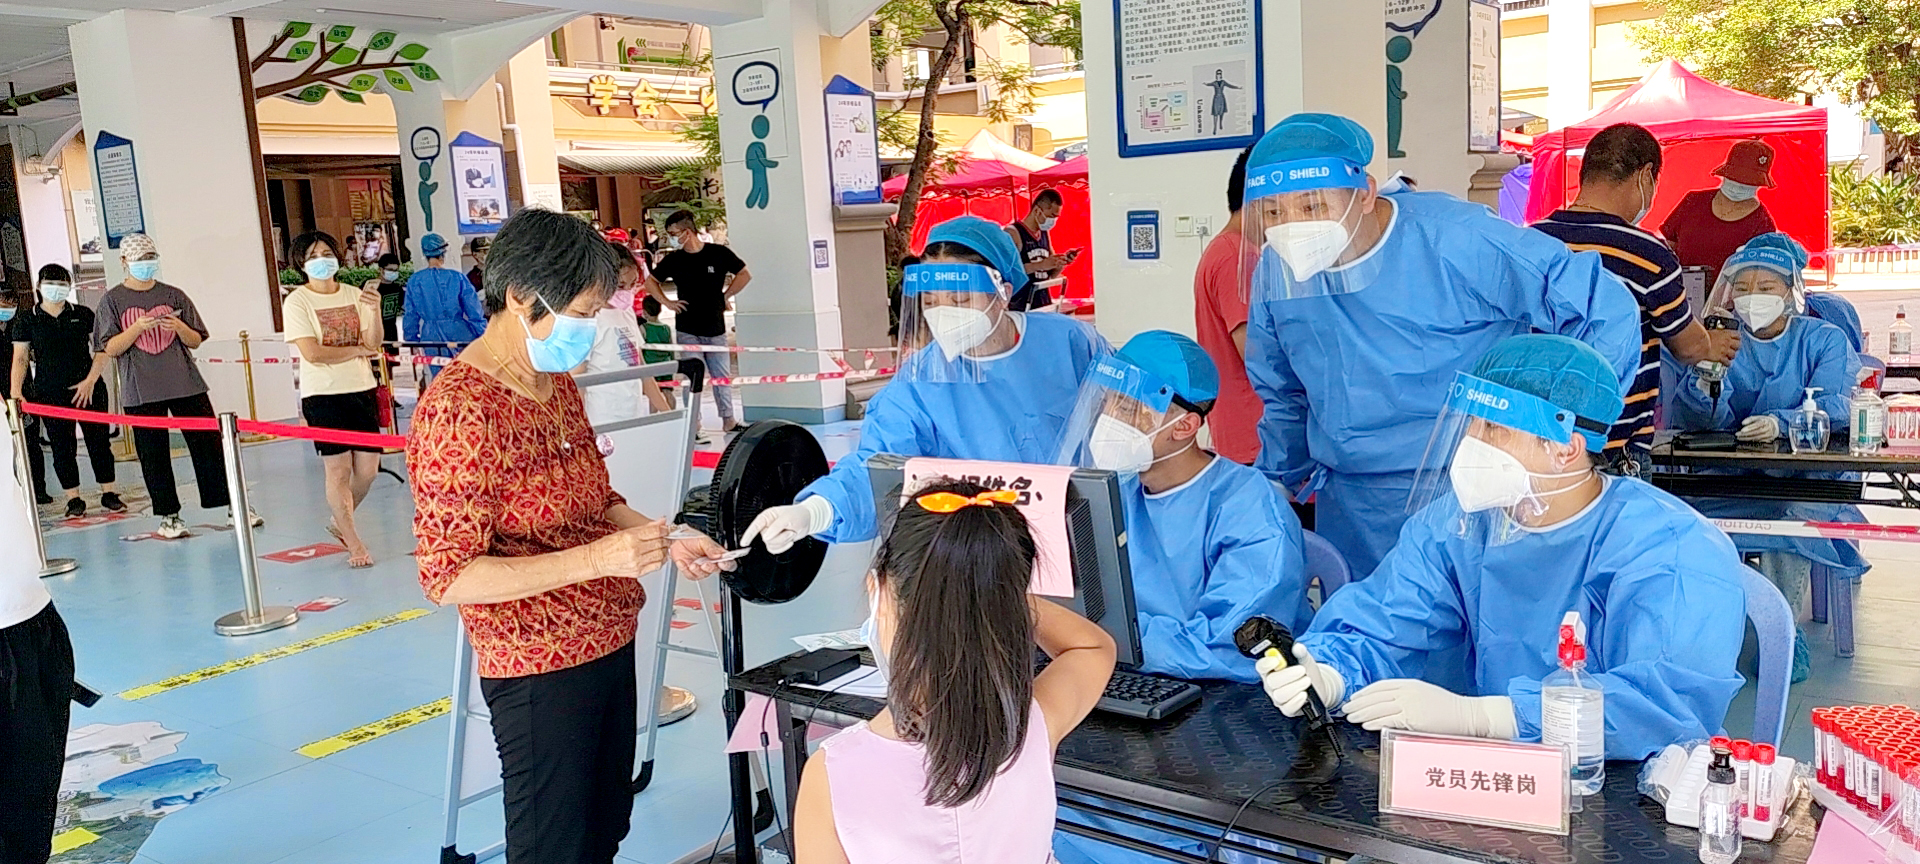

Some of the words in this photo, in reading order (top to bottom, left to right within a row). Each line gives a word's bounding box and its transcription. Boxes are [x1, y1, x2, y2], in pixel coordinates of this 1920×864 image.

[587, 74, 662, 118] 学会
[1247, 175, 1266, 188] FACE
[1289, 166, 1330, 180] SHIELD
[934, 271, 969, 281] SHIELD
[1096, 362, 1125, 380] SHIELD
[1466, 388, 1509, 411] SHIELD
[1425, 766, 1537, 795] 党员先锋岗
